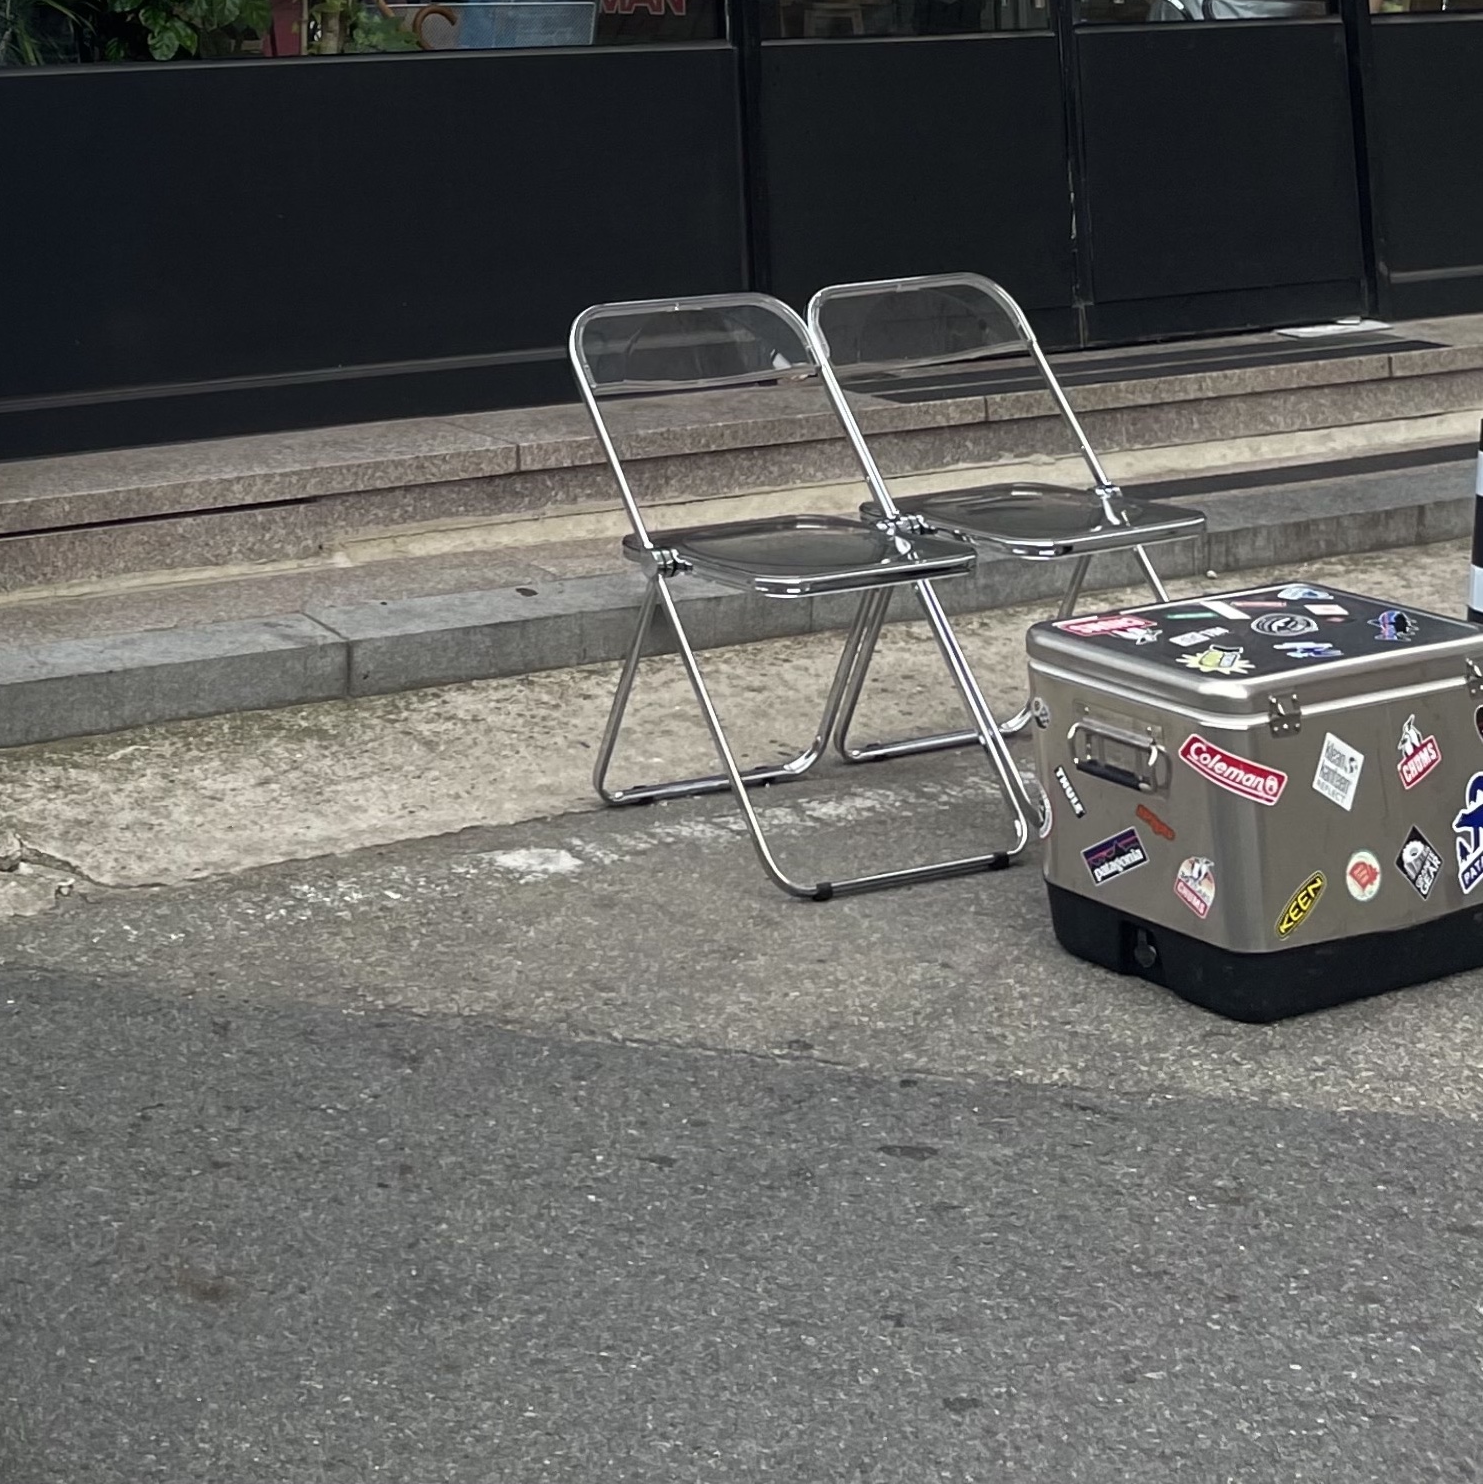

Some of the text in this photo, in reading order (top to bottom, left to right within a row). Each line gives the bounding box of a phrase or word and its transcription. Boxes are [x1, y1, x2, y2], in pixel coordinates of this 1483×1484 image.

[1056, 766, 1085, 816] THULE
[1190, 741, 1264, 794] Coleman
[1093, 846, 1144, 883] patagonia
[1421, 855, 1442, 895] GEAR
[1279, 877, 1323, 933] KEEN
